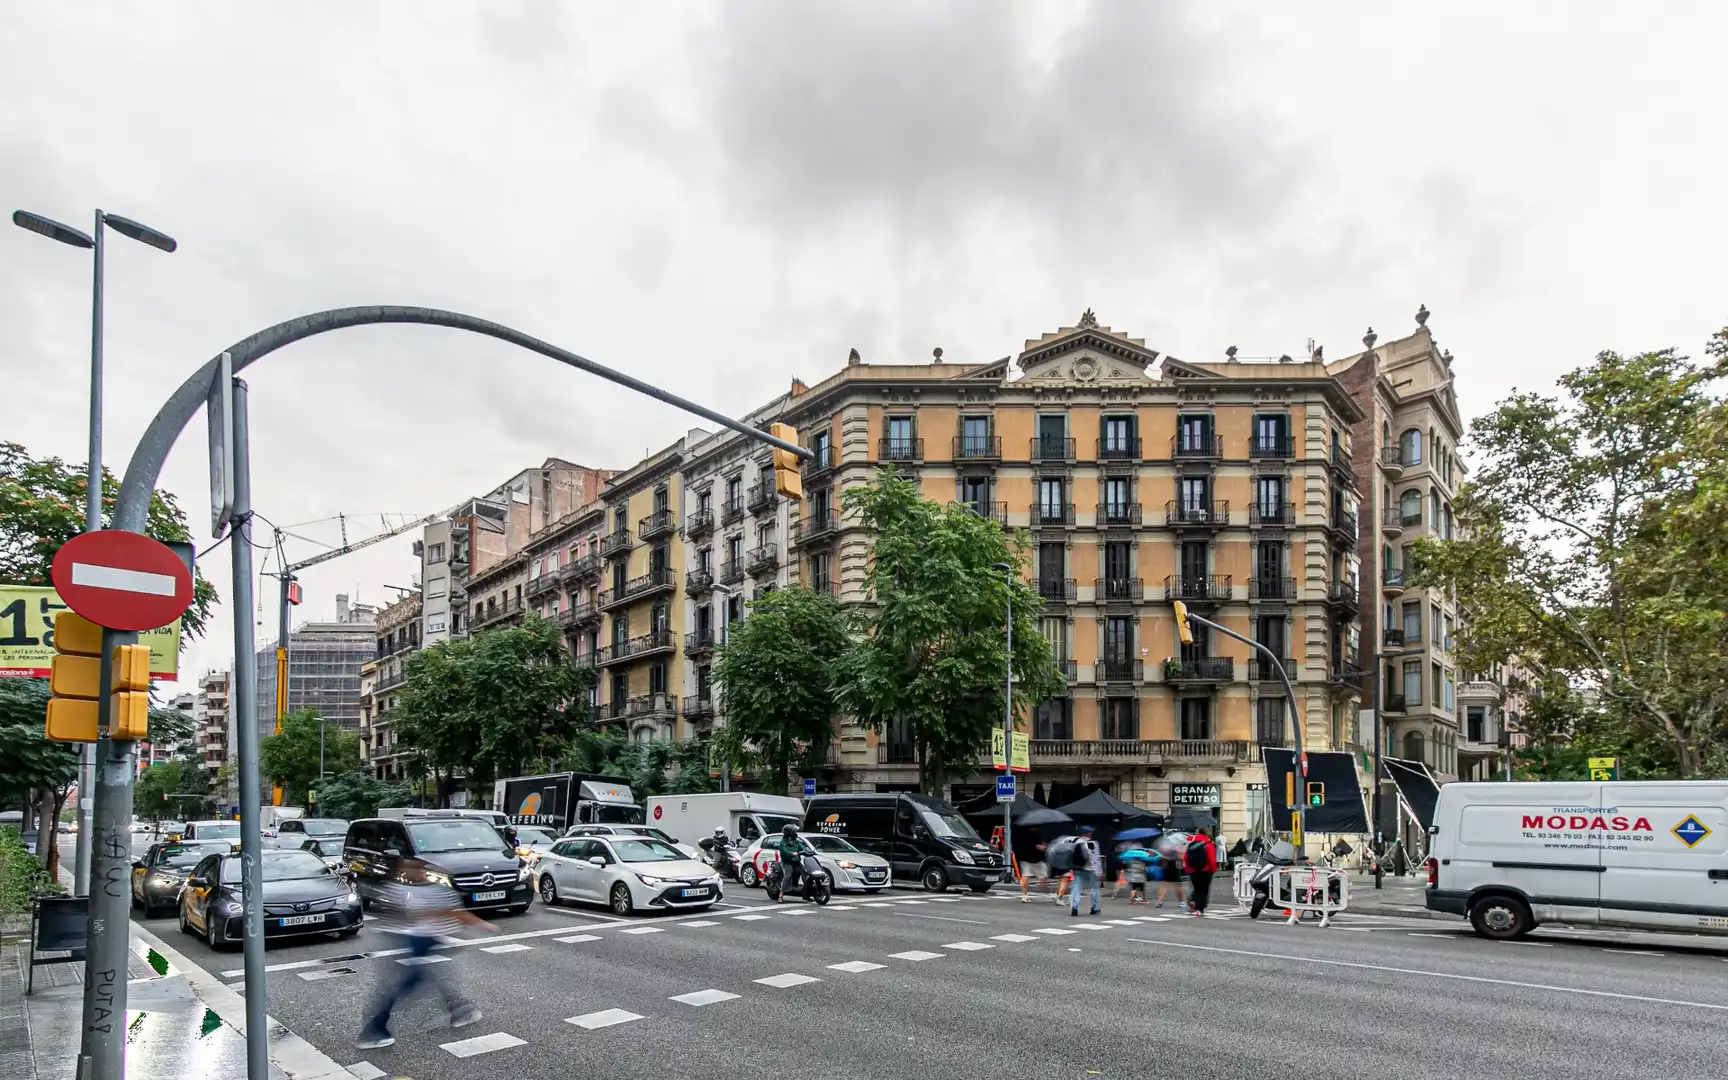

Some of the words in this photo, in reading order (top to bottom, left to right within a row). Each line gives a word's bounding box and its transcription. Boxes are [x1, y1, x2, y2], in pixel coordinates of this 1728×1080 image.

[154, 627, 172, 636] VIDA
[1174, 786, 1217, 794] GRANJA
[1174, 795, 1218, 803] PETITBO
[1521, 815, 1653, 831] MODASA
[1544, 843, 1628, 851] www.modasa.com
[285, 917, 305, 925] 3807
[88, 968, 116, 1033] PUTA!
